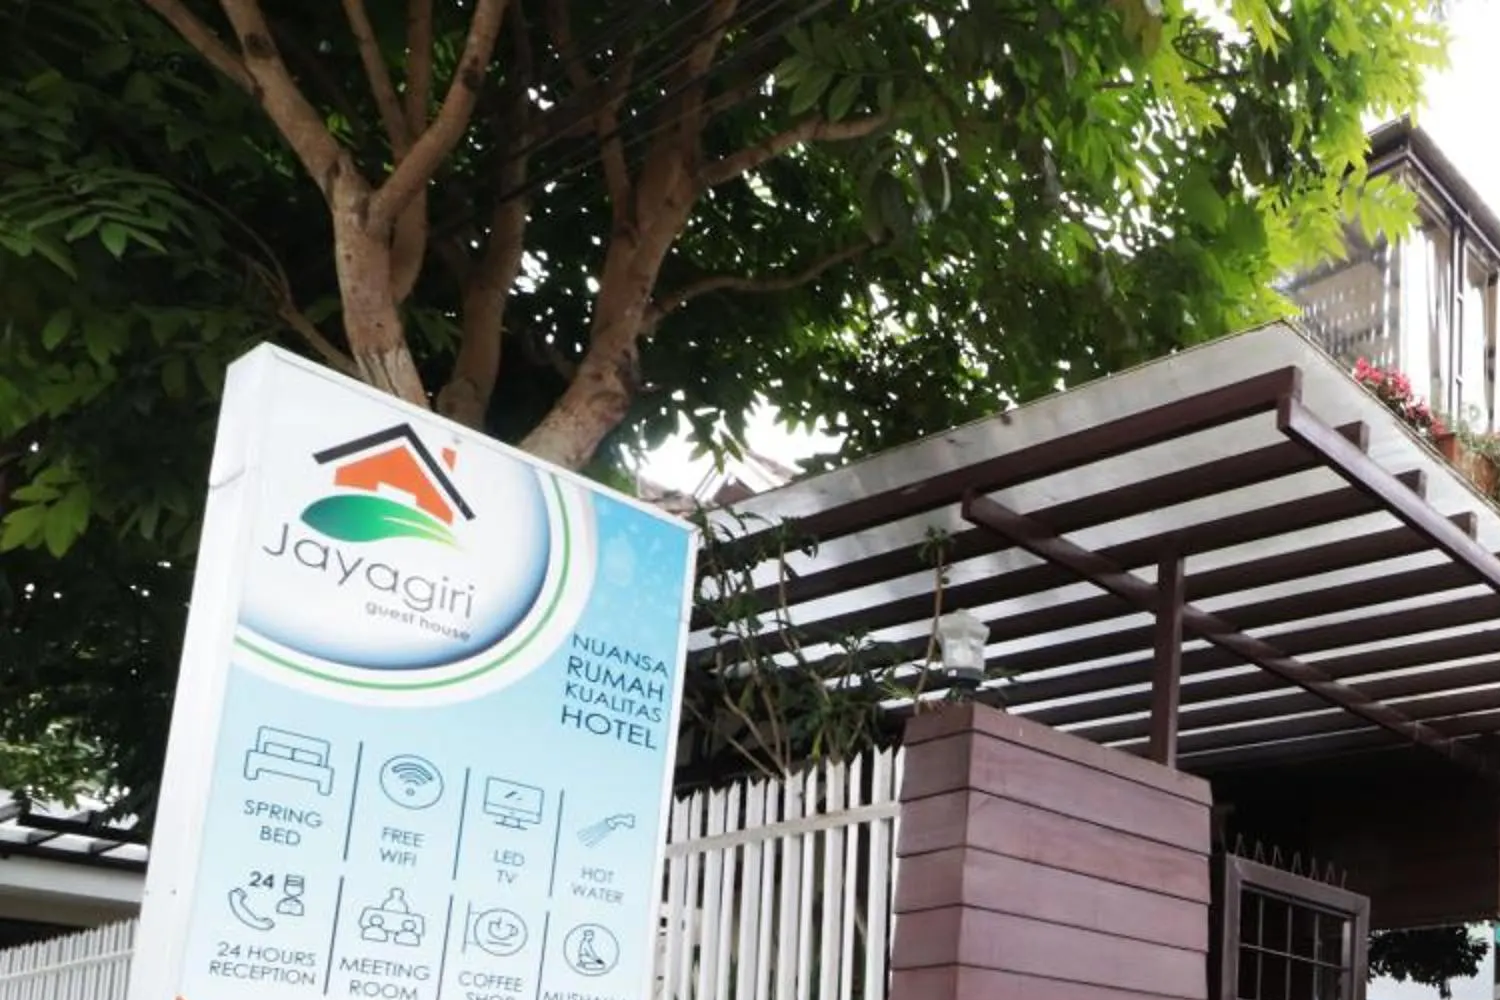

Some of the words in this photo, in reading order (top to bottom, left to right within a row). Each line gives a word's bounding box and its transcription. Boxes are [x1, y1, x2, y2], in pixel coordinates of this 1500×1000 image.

[262, 522, 475, 618] Jayagiri
[365, 600, 415, 625] guest
[419, 615, 471, 643] house
[573, 632, 669, 678] NUANSA
[567, 655, 664, 703] RUMAH
[565, 681, 662, 723] KUALITAS
[561, 704, 657, 750] HOTEL
[243, 799, 323, 829] SPRING
[259, 825, 301, 846] BED
[381, 826, 425, 848] FREE
[379, 848, 417, 867] WIFI
[493, 849, 526, 868] LED
[249, 871, 274, 889] 24
[496, 869, 518, 885] TV
[580, 867, 615, 884] HOT
[570, 882, 625, 905] WATER
[217, 941, 240, 958] 24
[247, 945, 316, 967] HOURS
[208, 960, 316, 986] RECEPTION
[339, 957, 431, 982] MEETING
[458, 971, 524, 994] COFFEE
